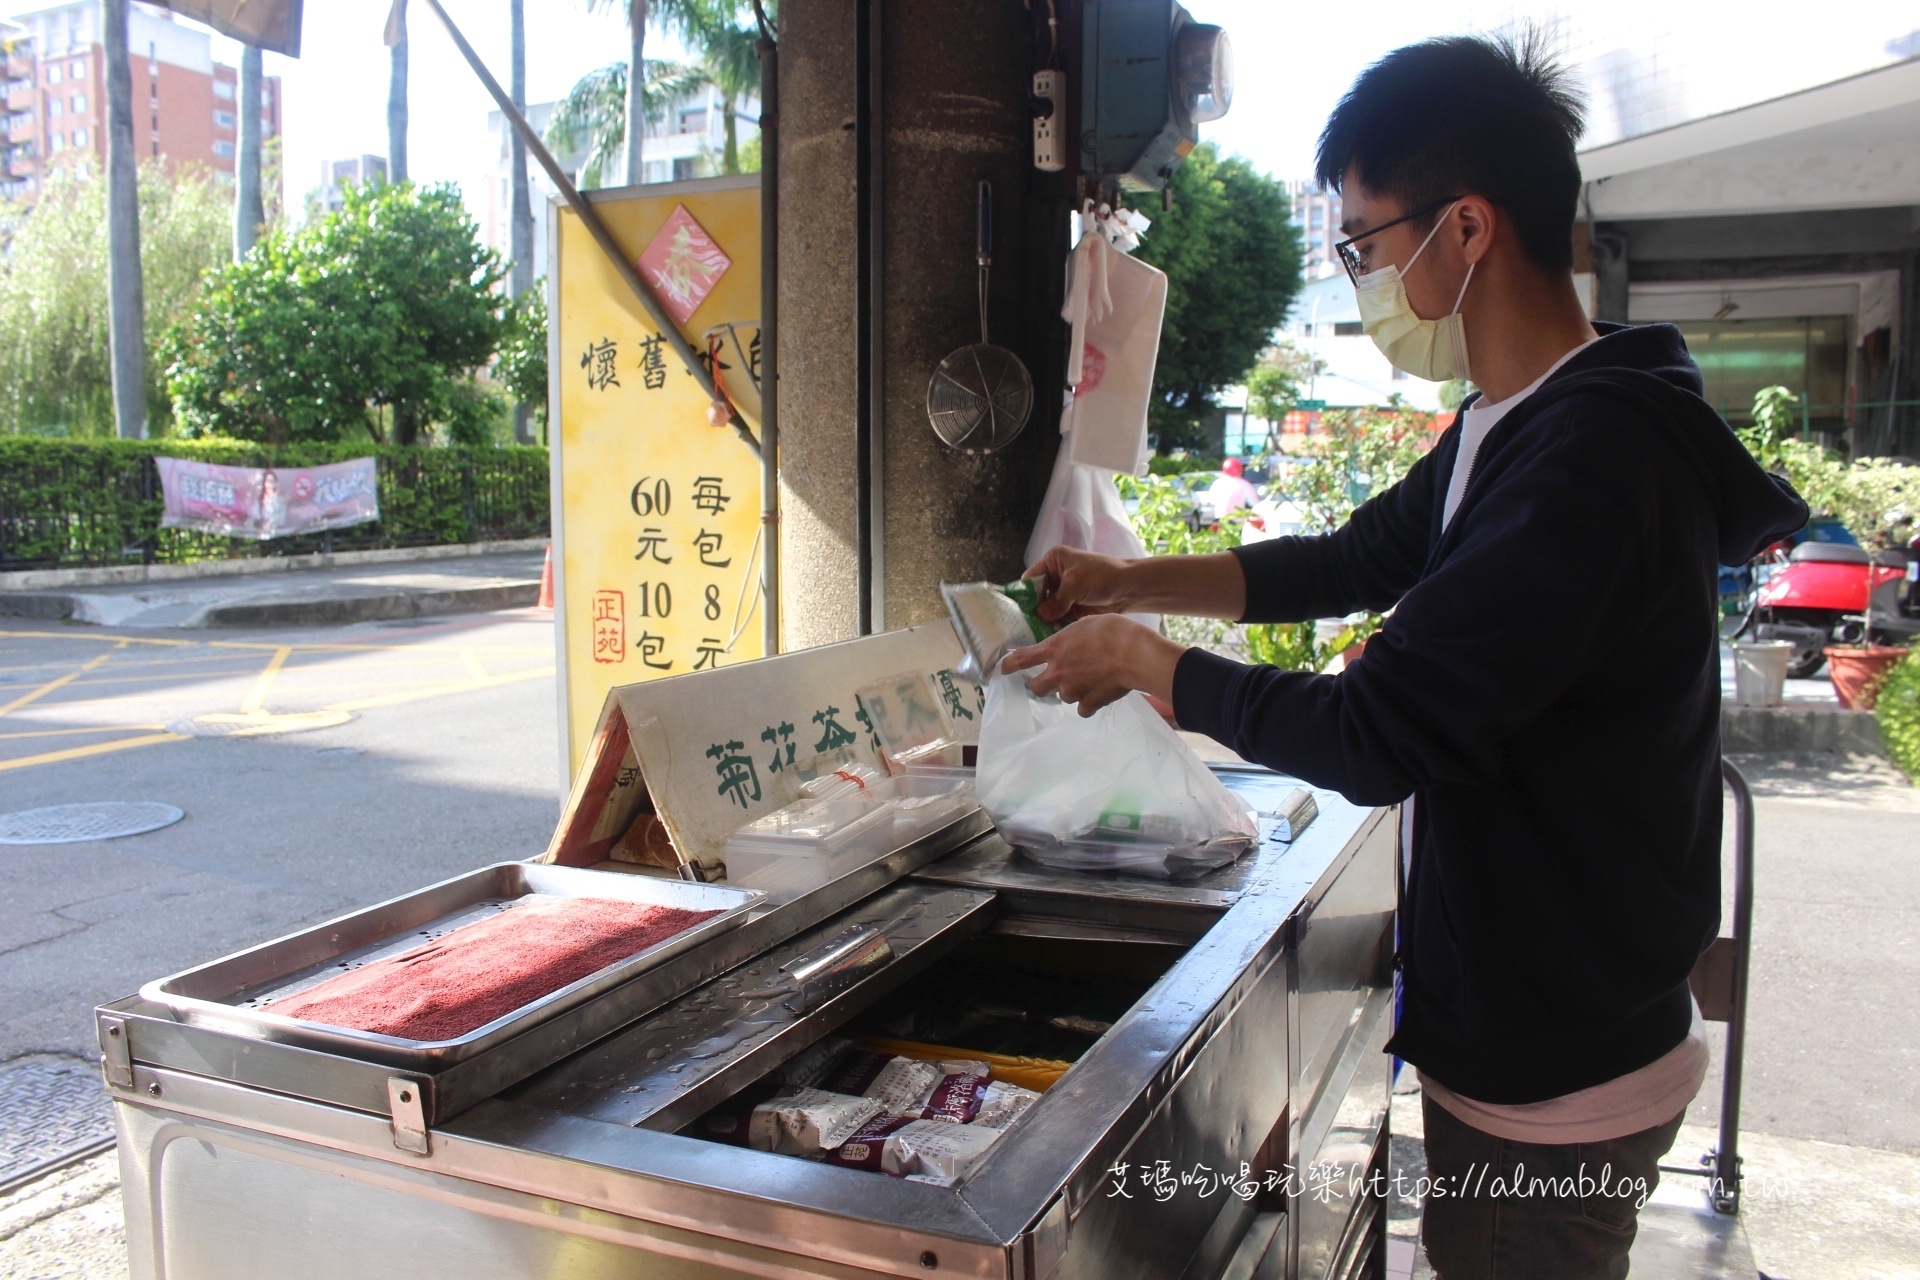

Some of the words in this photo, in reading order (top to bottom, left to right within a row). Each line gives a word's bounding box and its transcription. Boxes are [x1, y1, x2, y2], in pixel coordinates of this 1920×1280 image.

[595, 597, 623, 655] 正苑
[691, 476, 732, 670] 每包8元
